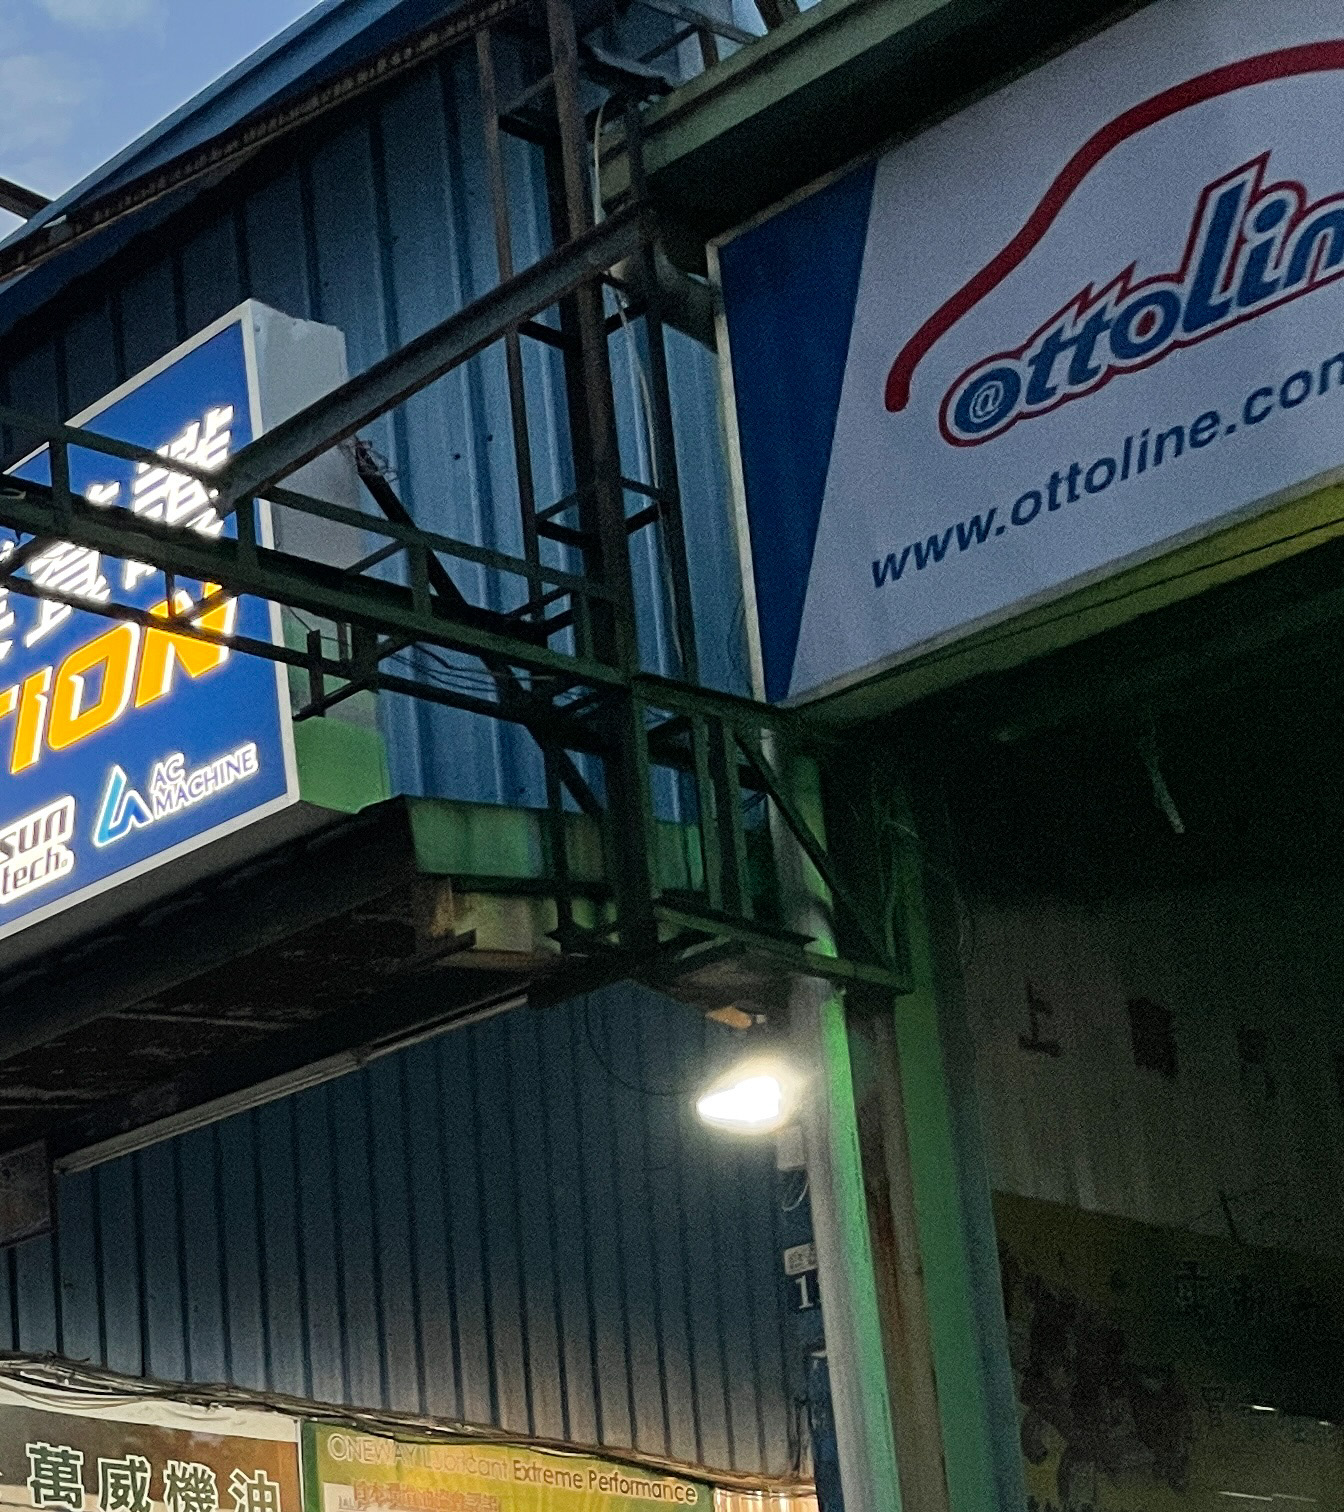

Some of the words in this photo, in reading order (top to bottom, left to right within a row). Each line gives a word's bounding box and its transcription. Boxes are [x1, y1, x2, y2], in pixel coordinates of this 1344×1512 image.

[154, 753, 185, 786] AC
[155, 748, 255, 813] MACHINE
[327, 1433, 417, 1466] ONEWAY
[513, 1459, 583, 1489] Extreme
[588, 1469, 697, 1505] Performance
